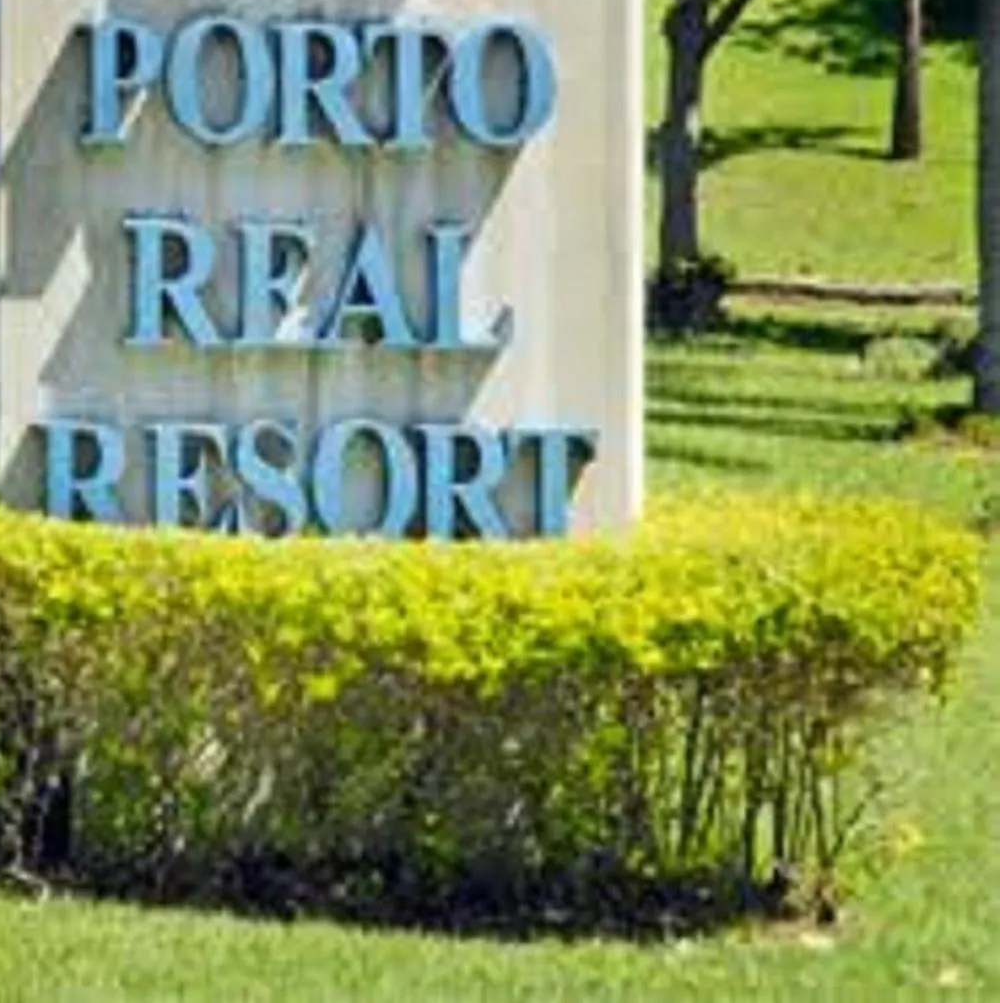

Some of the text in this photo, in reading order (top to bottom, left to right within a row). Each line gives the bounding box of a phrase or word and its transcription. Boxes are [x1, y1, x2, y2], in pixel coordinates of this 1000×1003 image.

[81, 12, 557, 148] PORTO
[123, 212, 513, 347] REAL
[34, 416, 598, 541] RESORT
